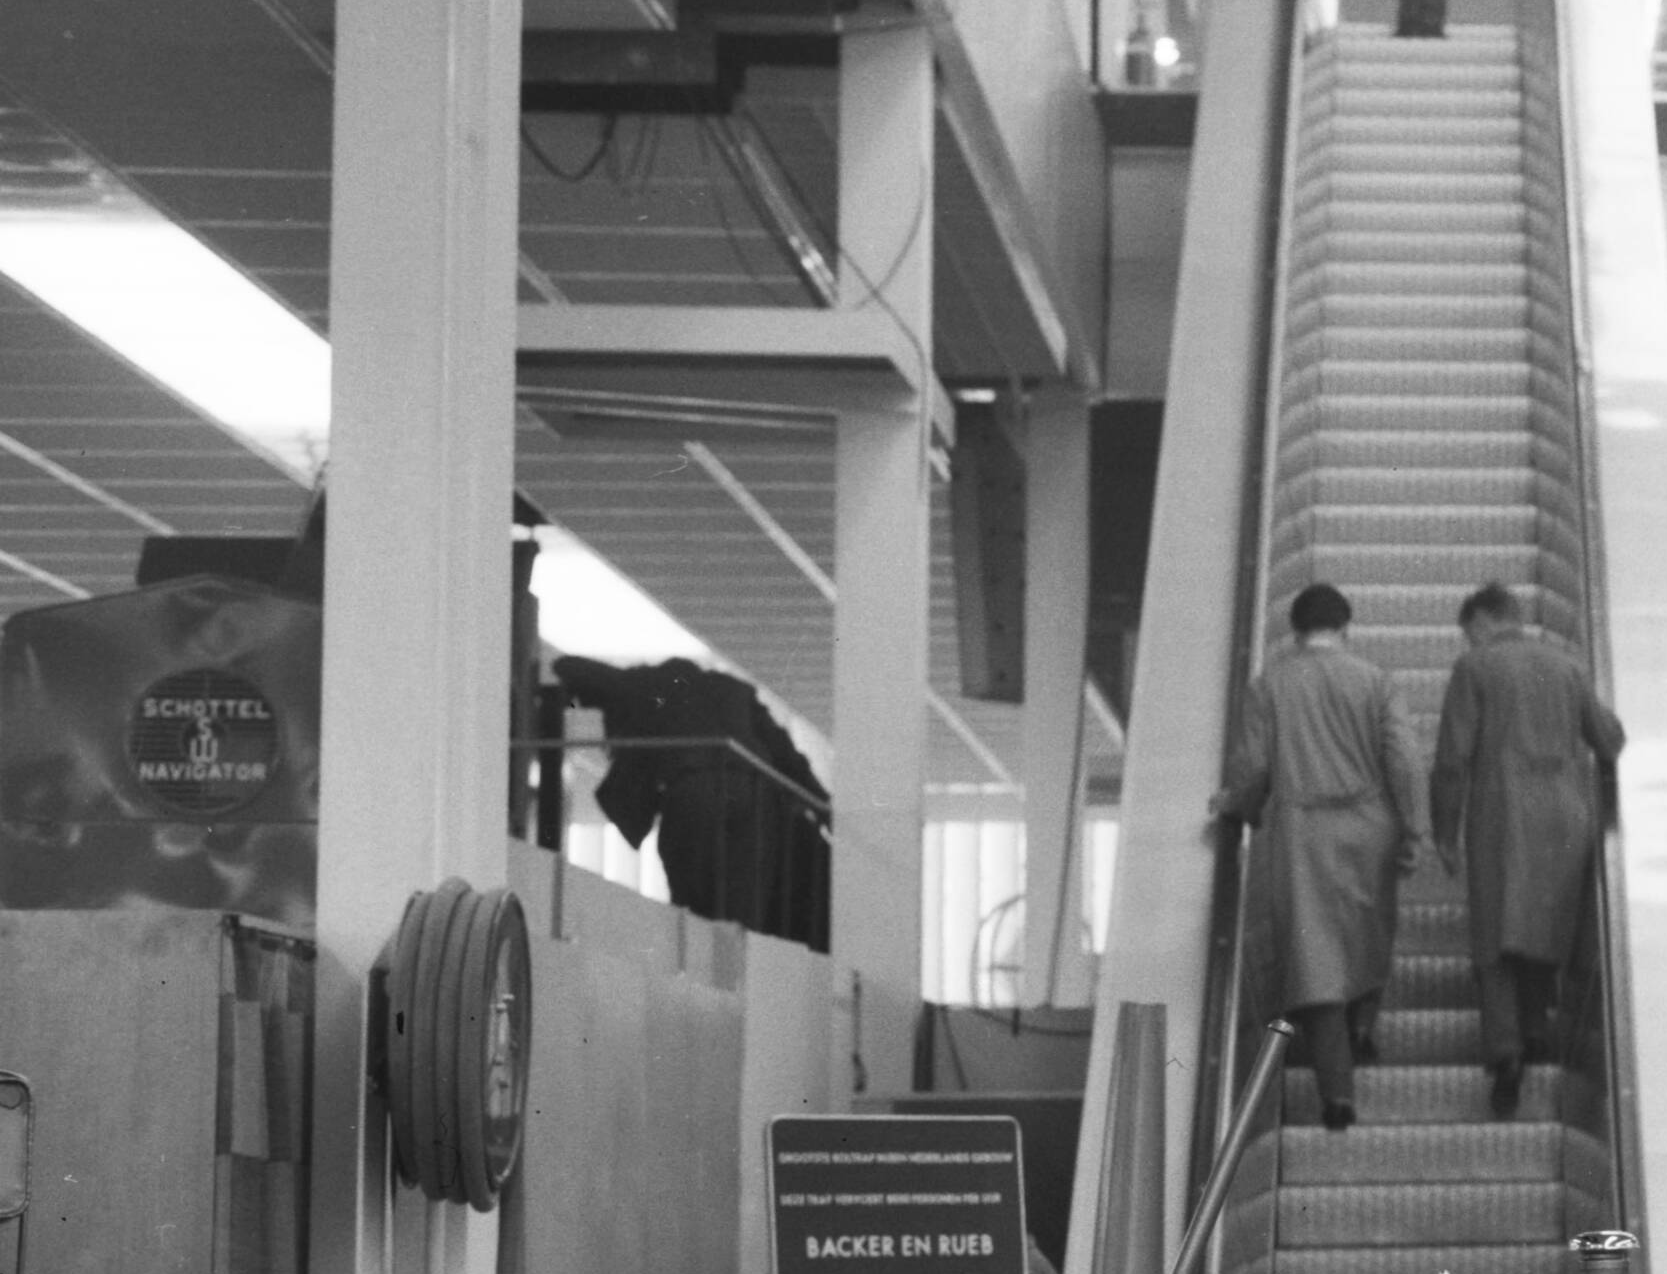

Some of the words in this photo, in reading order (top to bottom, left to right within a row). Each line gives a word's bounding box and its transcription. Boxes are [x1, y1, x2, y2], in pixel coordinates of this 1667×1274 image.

[143, 697, 271, 720] SCHOTTEL
[139, 762, 267, 782] NAVIGATOR
[806, 1235, 896, 1259] BACKER
[901, 1234, 932, 1258] EN
[937, 1233, 995, 1257] RUEB
